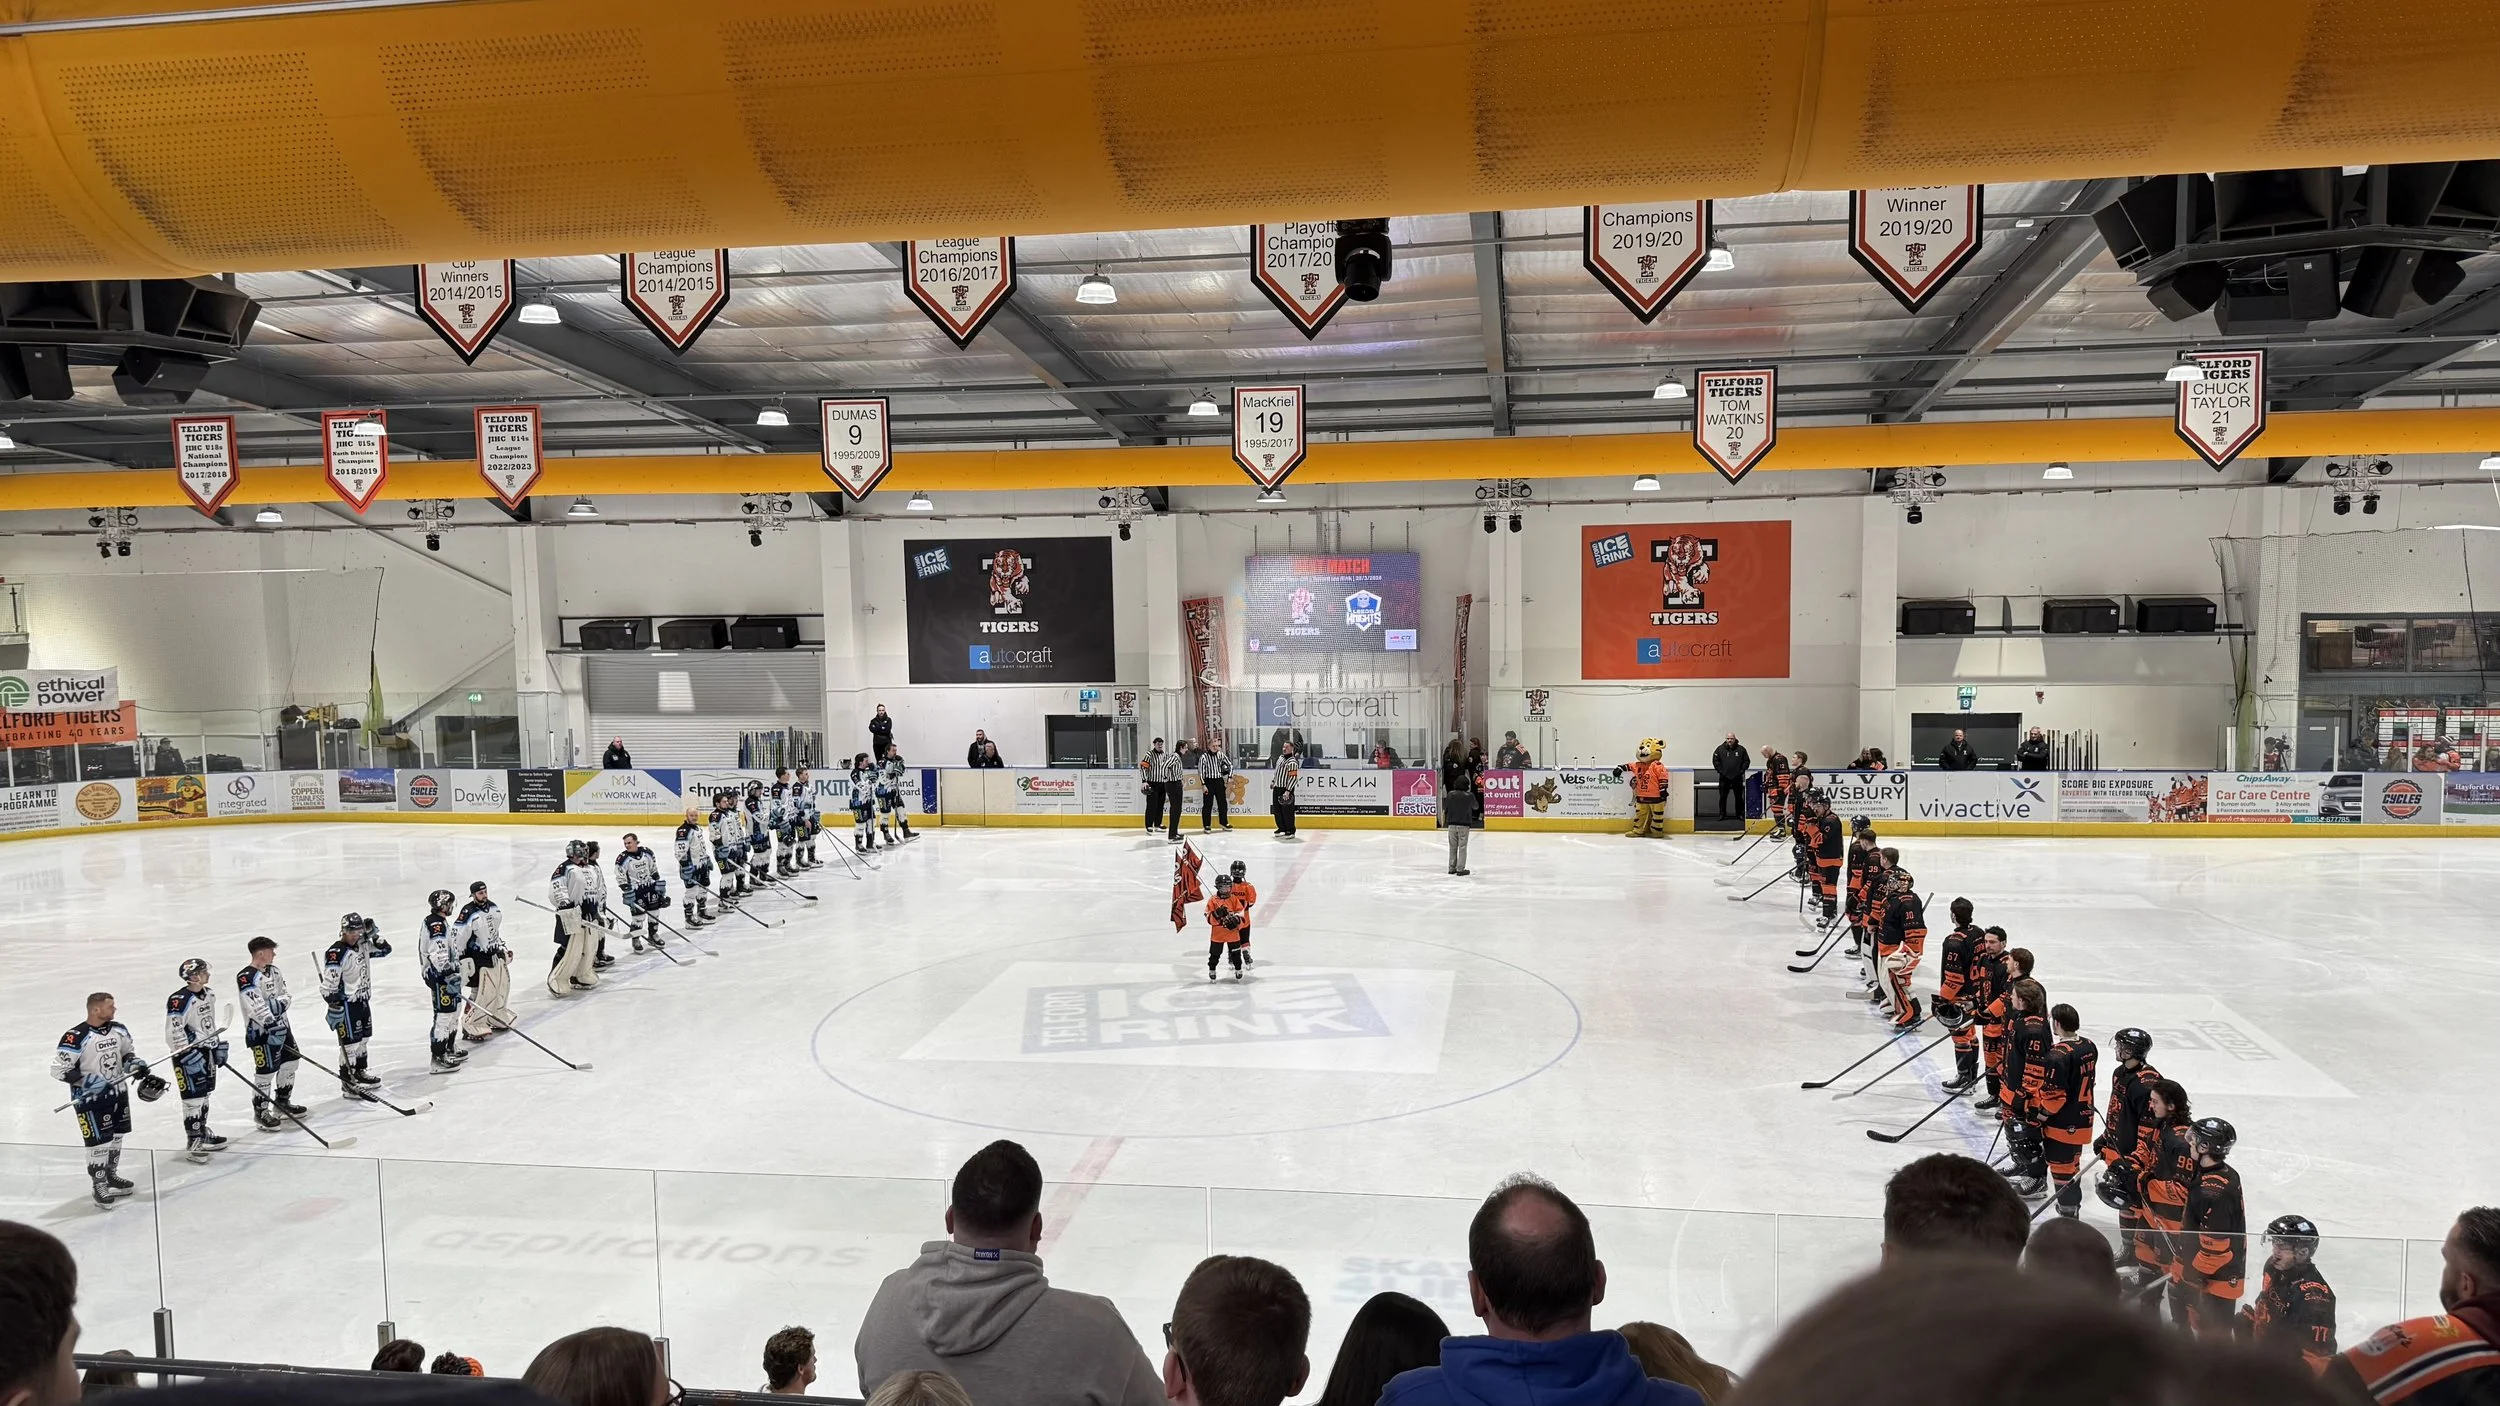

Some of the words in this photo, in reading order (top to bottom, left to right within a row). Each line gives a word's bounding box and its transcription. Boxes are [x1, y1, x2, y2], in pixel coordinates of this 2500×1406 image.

[1887, 198, 1947, 212] Winner
[1603, 210, 1693, 227] Champions
[1880, 219, 1952, 236] 2019/20
[936, 237, 980, 250] League
[1268, 235, 1336, 252] Champio
[1612, 231, 1683, 249] 2019/20
[919, 249, 998, 265] Champions
[1268, 252, 1335, 268] 2017/20
[638, 260, 713, 276] Champions
[920, 266, 998, 282] 2016/2017
[441, 271, 489, 283] Winners
[639, 277, 714, 293] 2014/2015
[429, 285, 503, 301] 2014/2015
[2199, 360, 2252, 369] ELFORD
[2203, 369, 2251, 380] IGERS
[1706, 378, 1764, 387] TELFORD
[2193, 382, 2249, 395] CHUCK
[1709, 387, 1762, 397] TIGERS
[1243, 396, 1294, 407] MacKriel
[1720, 400, 1750, 411] TOM
[2190, 396, 2251, 409] TAYLOR
[484, 415, 528, 423] TELFORD
[832, 409, 877, 420] DUMAS
[1706, 412, 1764, 425] WATKINS
[2212, 411, 2229, 424] 21
[488, 424, 528, 432] TIGERS
[1256, 412, 1283, 433] 19
[185, 433, 223, 441] TIGERS
[849, 425, 862, 445] 9
[1726, 427, 1744, 439] 20
[1245, 438, 1294, 448] 1995/2017
[833, 450, 880, 459] 1995/2009
[1598, 534, 1629, 555] ICE
[920, 548, 947, 567] ICE
[1602, 548, 1632, 564] RINK
[924, 561, 950, 576] RINK
[1327, 559, 1371, 574] MATCH
[1650, 612, 1718, 625] TIGERS
[980, 621, 1039, 632] TIGERS
[1284, 628, 1320, 636] TIGERS
[979, 646, 1053, 663] autocraft
[1648, 640, 1733, 657] autocraft
[37, 676, 105, 692] ethical
[37, 690, 105, 706] power
[1272, 692, 1399, 717] autocraft
[1963, 699, 1969, 707] 9
[0, 711, 55, 729] LFORD
[66, 708, 121, 725] TIGERS
[90, 726, 125, 736] YEARS
[1030, 776, 1075, 790] Cartwrights
[1560, 773, 1585, 784] Vets
[1598, 773, 1624, 785] Pets
[2061, 780, 2088, 788] SCORE
[2092, 780, 2106, 788] BIG
[2109, 780, 2153, 788] EXPOSURE
[2236, 774, 2291, 784] ChipsAway
[410, 787, 437, 796] CYCLES
[2455, 783, 2484, 792] Hayford
[10, 790, 41, 801] LEARN
[46, 789, 57, 797] TO
[454, 788, 507, 808] Dawley
[2216, 790, 2236, 800] Car
[2239, 790, 2267, 800] Care
[2270, 790, 2310, 800] Centre
[2382, 794, 2422, 804] CYCLES
[218, 798, 267, 809] integrated
[1919, 798, 2031, 818] vivactive
[1905, 911, 1914, 919] 30
[1947, 952, 1959, 961] 67
[1099, 979, 1348, 1020] ICE
[1042, 991, 1086, 1047] TELFORD
[1100, 1009, 1365, 1044] RINK
[2177, 1155, 2194, 1171] 98
[422, 1228, 871, 1268] aspirations
[2311, 1325, 2329, 1342] 77
